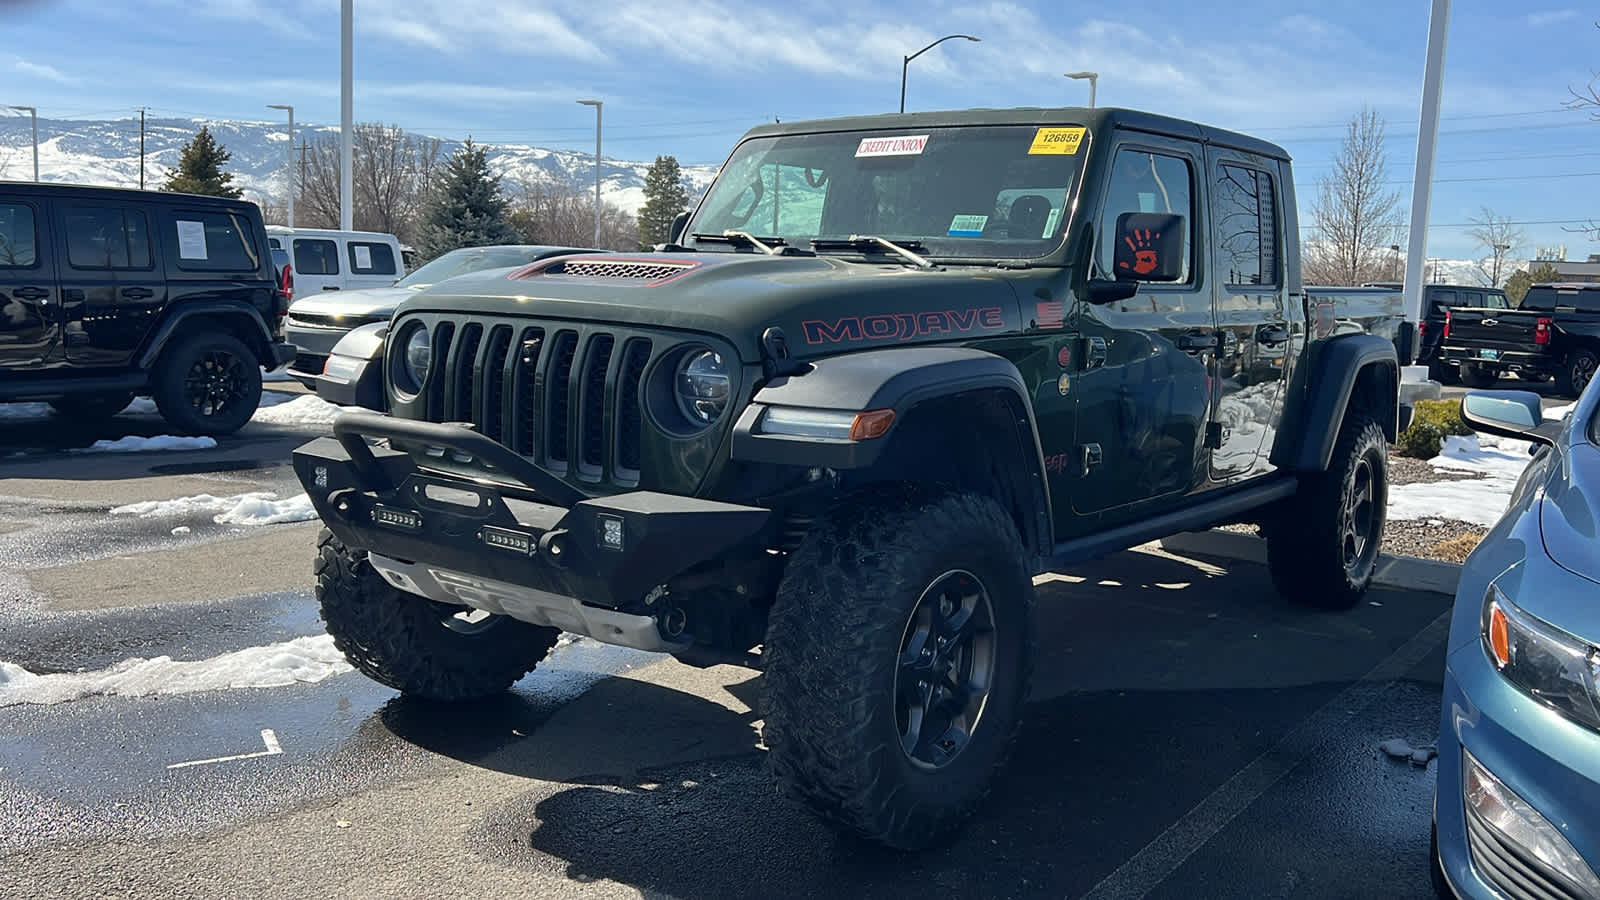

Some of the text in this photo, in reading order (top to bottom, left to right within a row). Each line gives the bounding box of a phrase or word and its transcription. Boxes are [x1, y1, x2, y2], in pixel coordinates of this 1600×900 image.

[859, 138, 925, 153] CREDIT UNION
[1043, 133, 1079, 143] 126859
[802, 307, 1005, 344] MOJAVE
